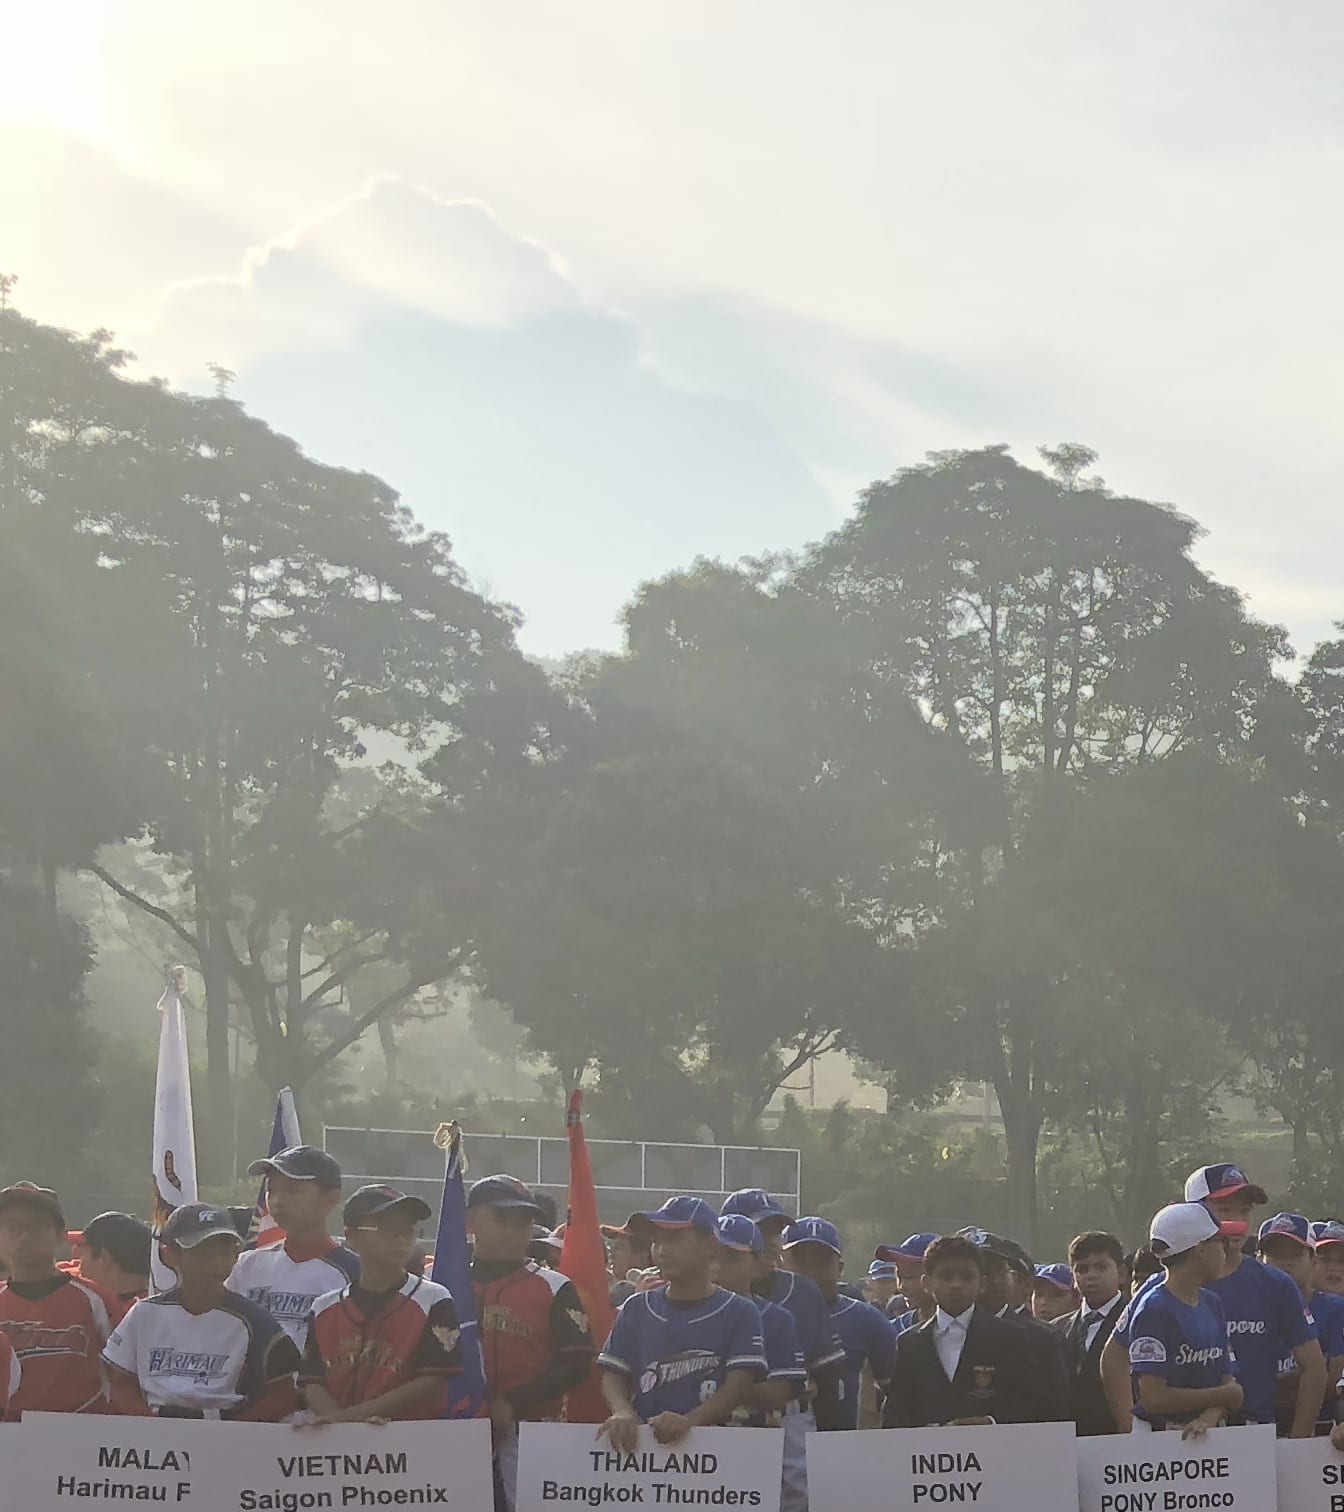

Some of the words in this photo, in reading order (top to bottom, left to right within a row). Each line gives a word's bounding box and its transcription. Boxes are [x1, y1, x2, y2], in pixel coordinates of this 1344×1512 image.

[807, 1222, 823, 1237] T
[277, 1452, 407, 1478] VIETNAM
[588, 1451, 718, 1474] THAILAND
[911, 1452, 982, 1475] INDIA
[1103, 1457, 1229, 1485] SINGAPORE
[56, 1475, 167, 1503] Harimau
[342, 1483, 449, 1507] Phoenix
[542, 1481, 645, 1507] Bangkok
[652, 1483, 761, 1506] Thunders
[912, 1481, 983, 1504] PONY
[1164, 1490, 1234, 1510] Bronco
